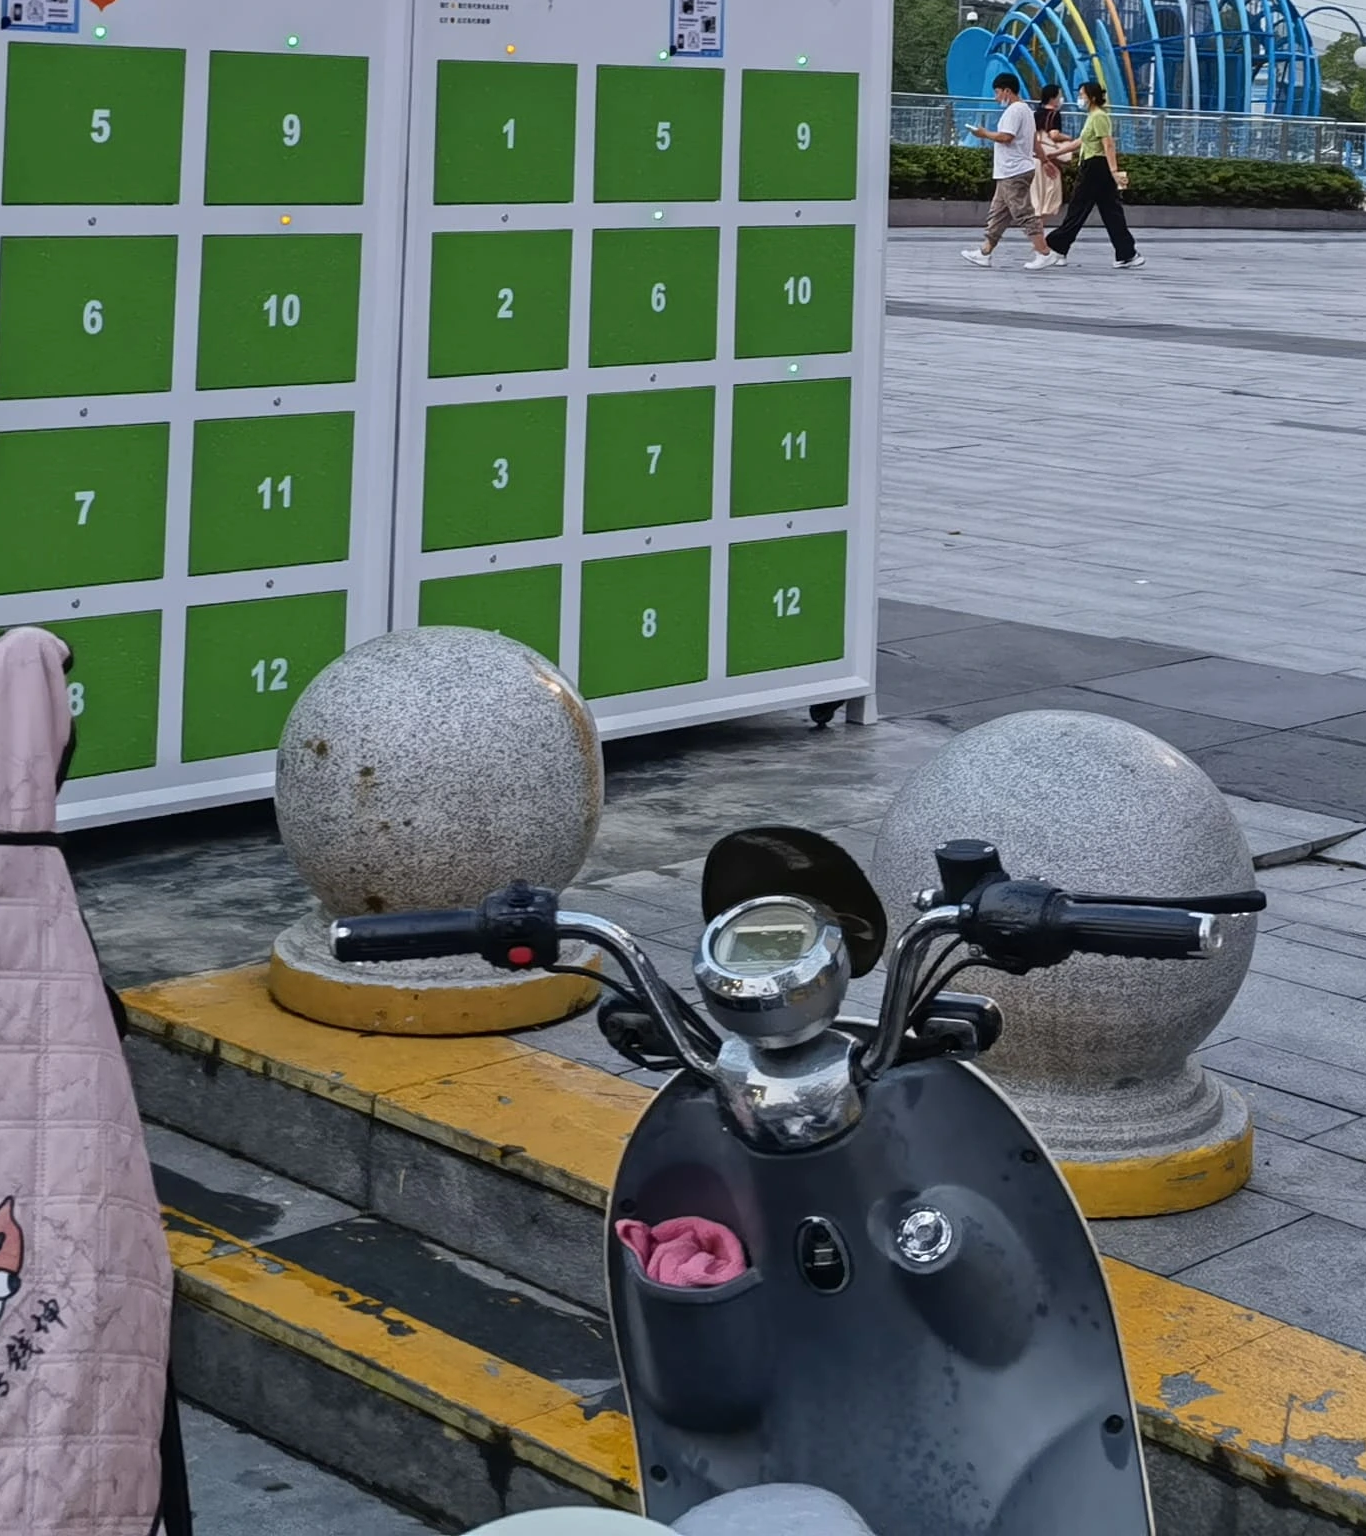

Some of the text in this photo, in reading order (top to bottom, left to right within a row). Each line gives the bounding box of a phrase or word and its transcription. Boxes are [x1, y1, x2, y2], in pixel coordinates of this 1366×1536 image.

[90, 108, 111, 144] 5
[282, 113, 301, 147] 9
[502, 118, 516, 149] 1
[655, 121, 672, 151] 5
[796, 122, 811, 151] 9
[497, 287, 514, 319] 2
[651, 282, 667, 313] 6
[783, 276, 812, 305] 10
[82, 299, 103, 335] 6
[263, 293, 301, 327] 10
[646, 444, 662, 475] 7
[781, 430, 807, 460] 11
[492, 458, 509, 489] 3
[74, 490, 95, 525] 7
[257, 475, 292, 510] 11
[773, 586, 801, 617] 12
[641, 608, 657, 638] 8
[251, 657, 288, 693] 12
[66, 681, 85, 717] 8
